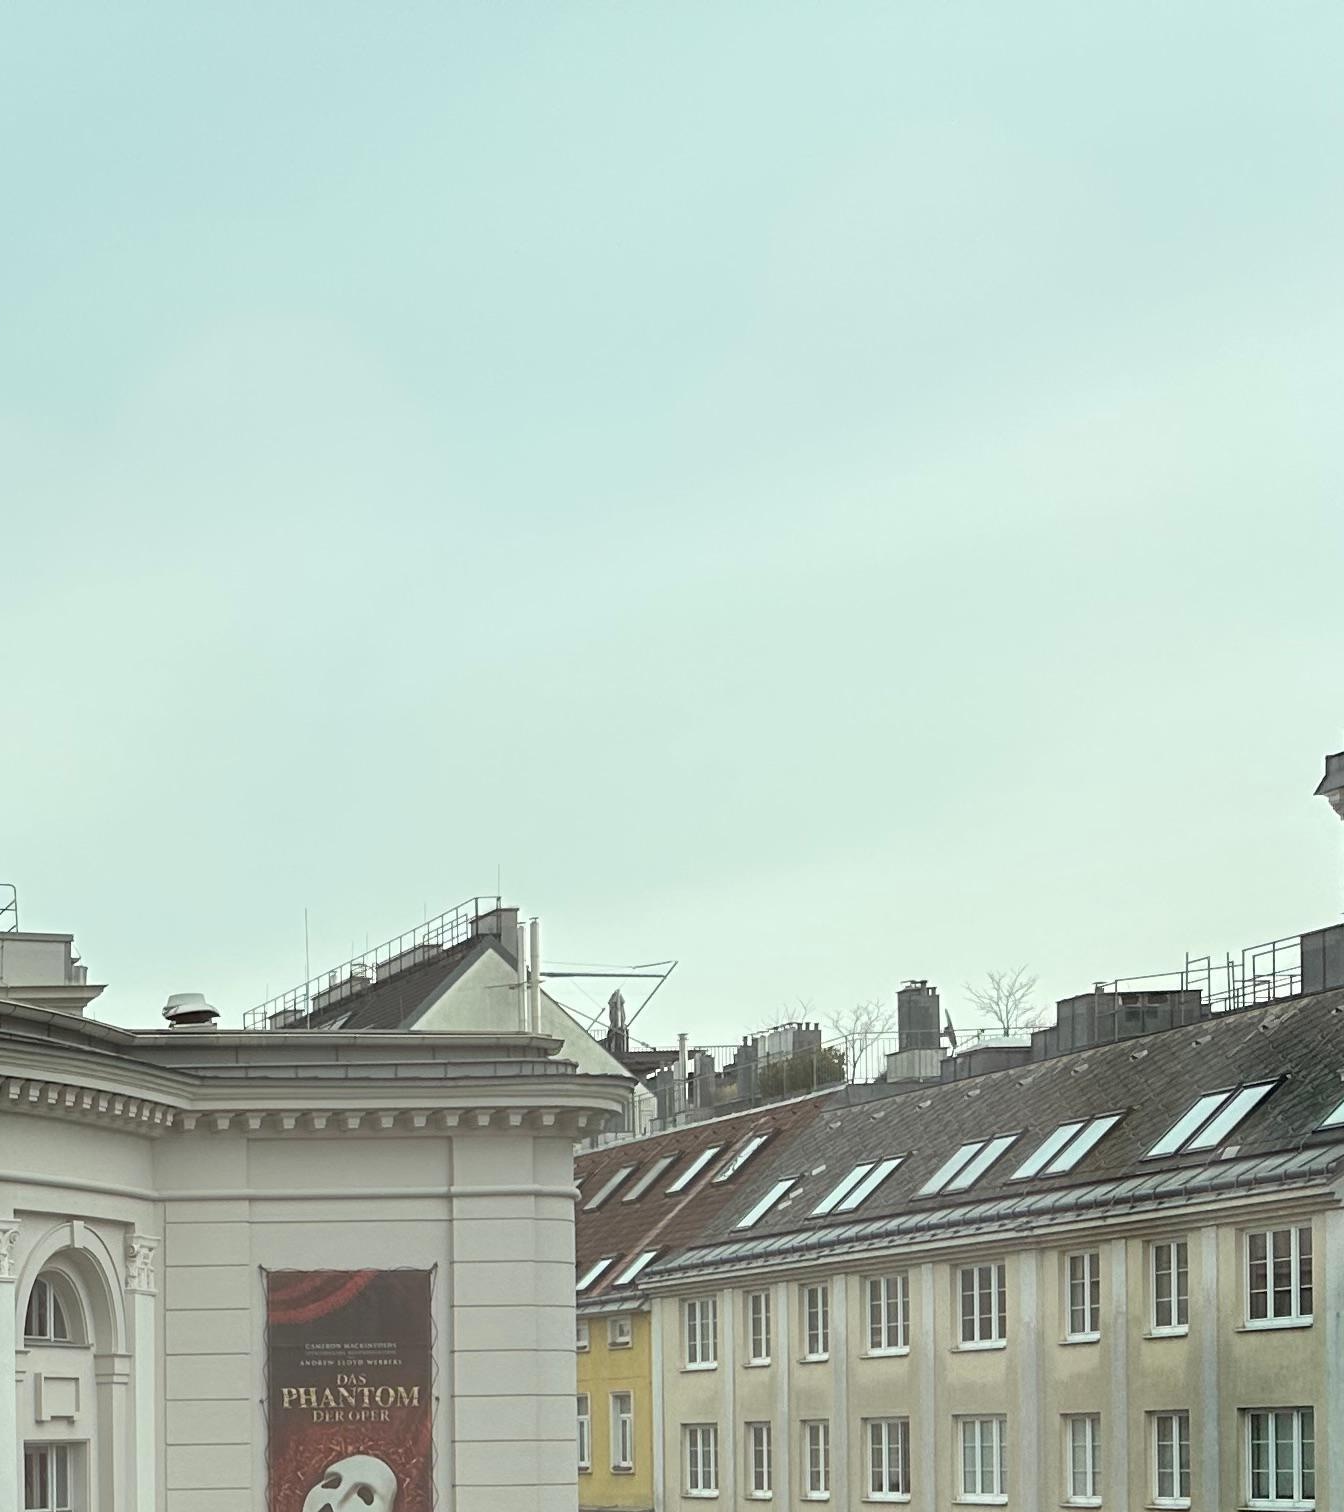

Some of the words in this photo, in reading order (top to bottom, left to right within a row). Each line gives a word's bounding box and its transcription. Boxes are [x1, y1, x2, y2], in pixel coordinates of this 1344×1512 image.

[336, 1374, 367, 1386] DAS
[281, 1386, 421, 1409] PHANTOM
[313, 1410, 345, 1423] DER
[348, 1409, 391, 1422] OPER
